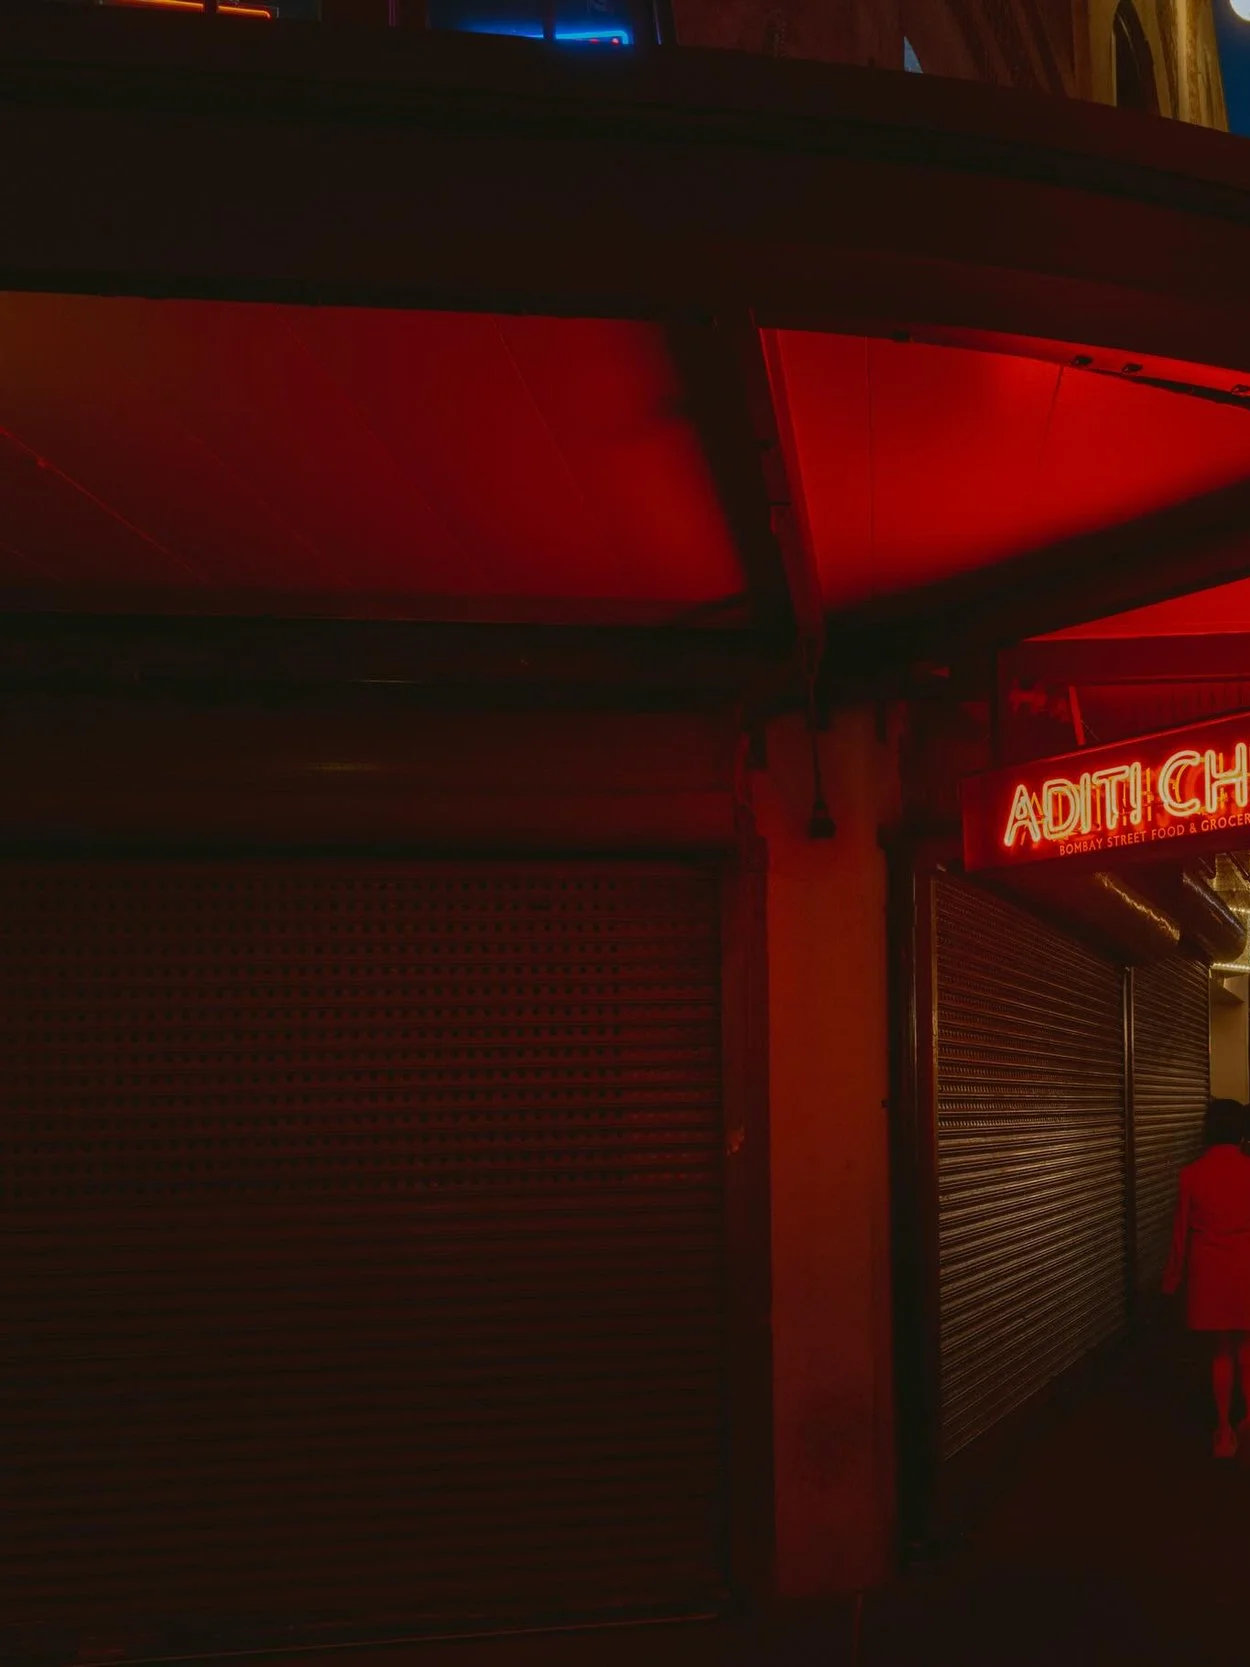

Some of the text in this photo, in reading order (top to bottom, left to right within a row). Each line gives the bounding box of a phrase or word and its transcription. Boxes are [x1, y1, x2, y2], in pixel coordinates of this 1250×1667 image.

[1003, 762, 1142, 847] ADITI
[1059, 838, 1103, 856] BOMBAY
[1107, 831, 1147, 848] STREET
[1151, 824, 1185, 841] FOOD
[1189, 822, 1198, 834] &
